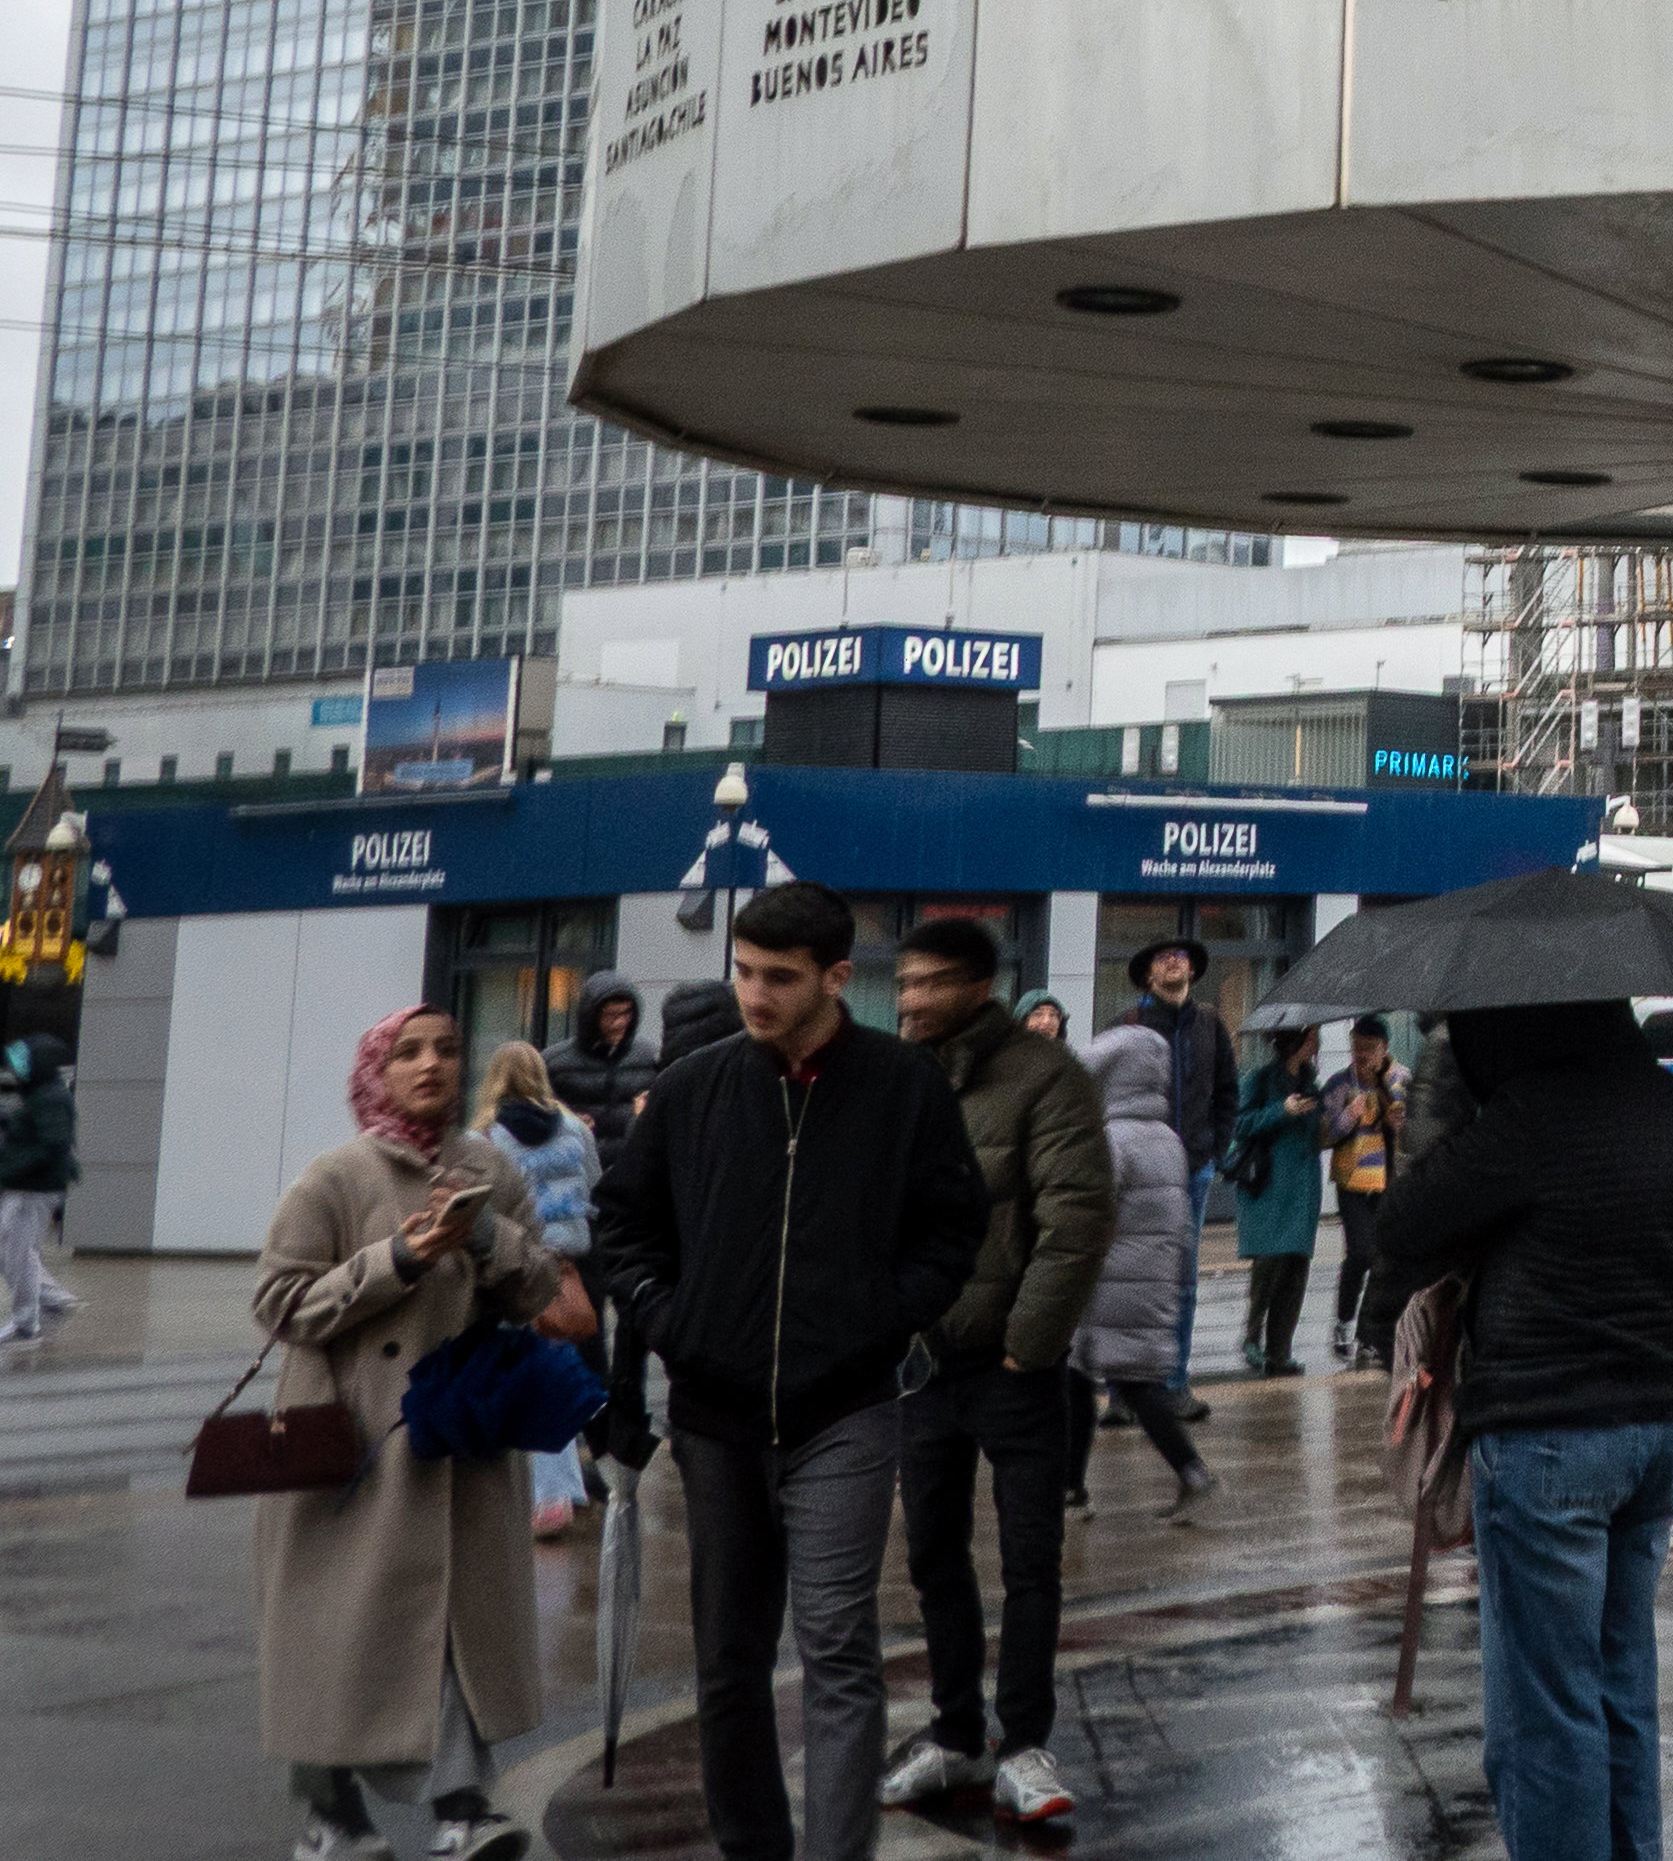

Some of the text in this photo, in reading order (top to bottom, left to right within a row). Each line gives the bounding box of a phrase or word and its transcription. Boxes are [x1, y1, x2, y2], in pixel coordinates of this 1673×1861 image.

[636, 14, 683, 71] LA PAZ
[750, 30, 929, 108] BUENOS AIRES
[767, 636, 861, 681] POLIZEI
[904, 635, 1020, 680] POLIZEI
[351, 829, 432, 870] POLIZEI
[1163, 822, 1257, 857] POLIZEI
[1141, 859, 1276, 880] Wache am Alexanderplatz
